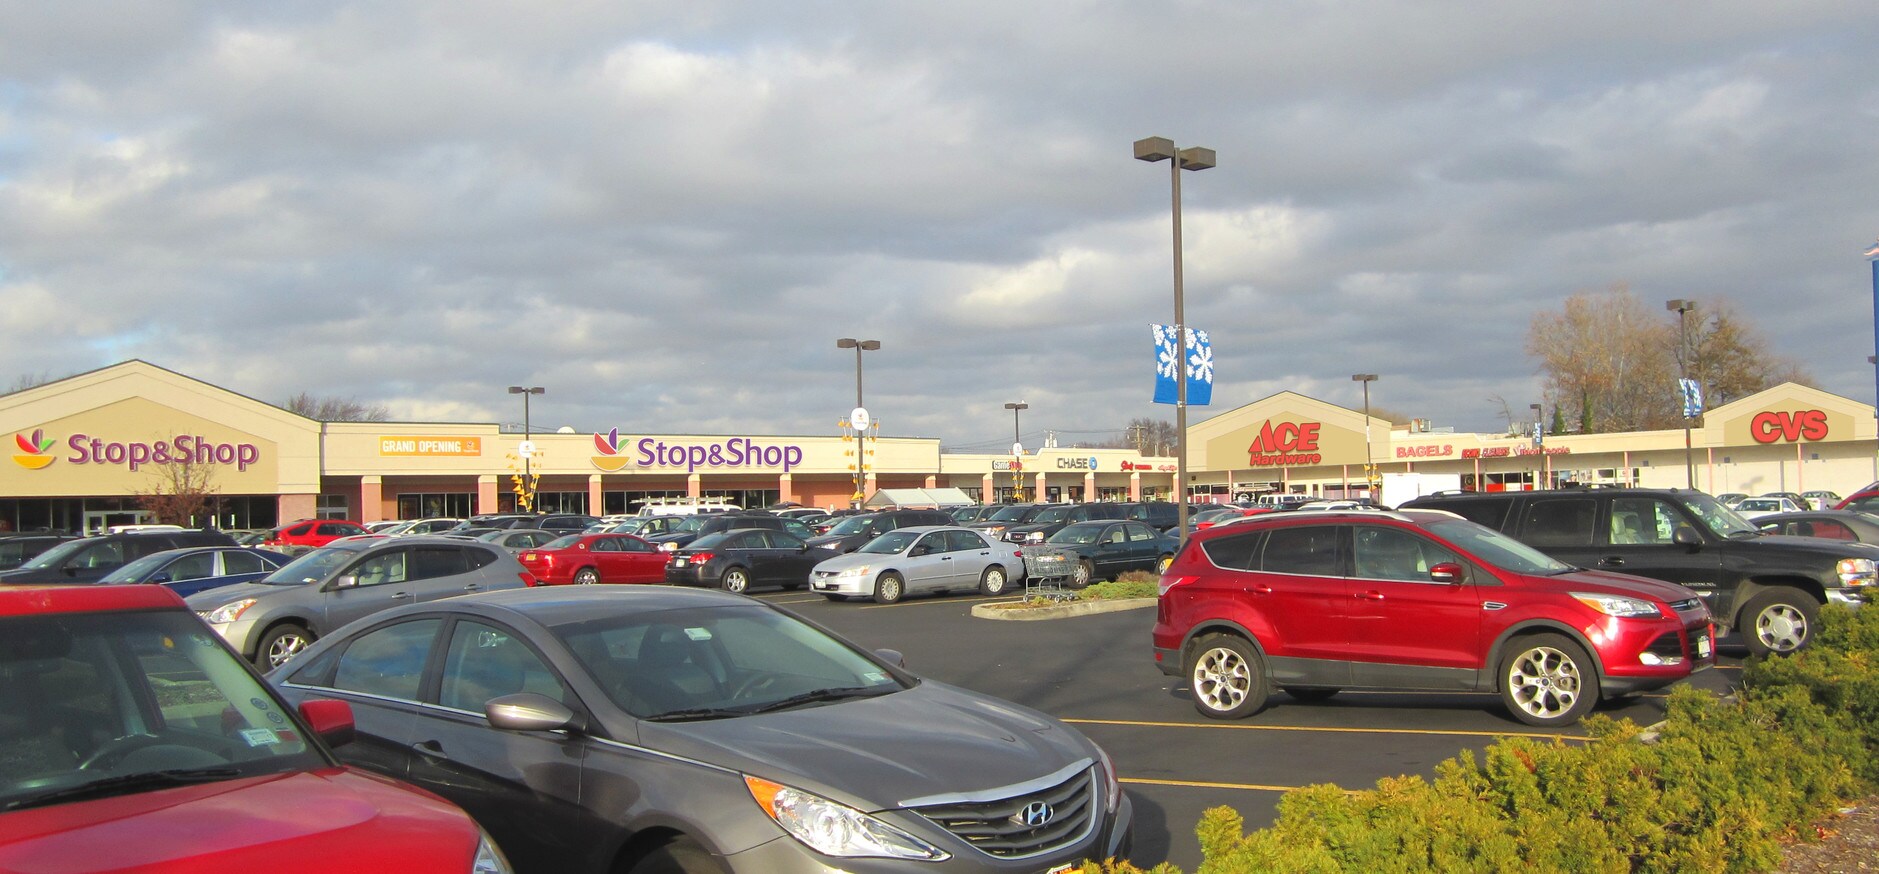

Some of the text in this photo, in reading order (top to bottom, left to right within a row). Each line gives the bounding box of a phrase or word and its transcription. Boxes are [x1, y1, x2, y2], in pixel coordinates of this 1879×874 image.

[1751, 410, 1829, 443] CVS
[1248, 419, 1321, 453] ACE
[67, 433, 260, 472] Stop&Shop
[382, 440, 461, 453] GRAND OPENING
[1396, 444, 1453, 458] BAGELS
[1541, 446, 1570, 455] eople
[637, 438, 803, 473] Stop&Shop
[1250, 452, 1321, 466] Hardware
[1057, 457, 1088, 469] CHASE
